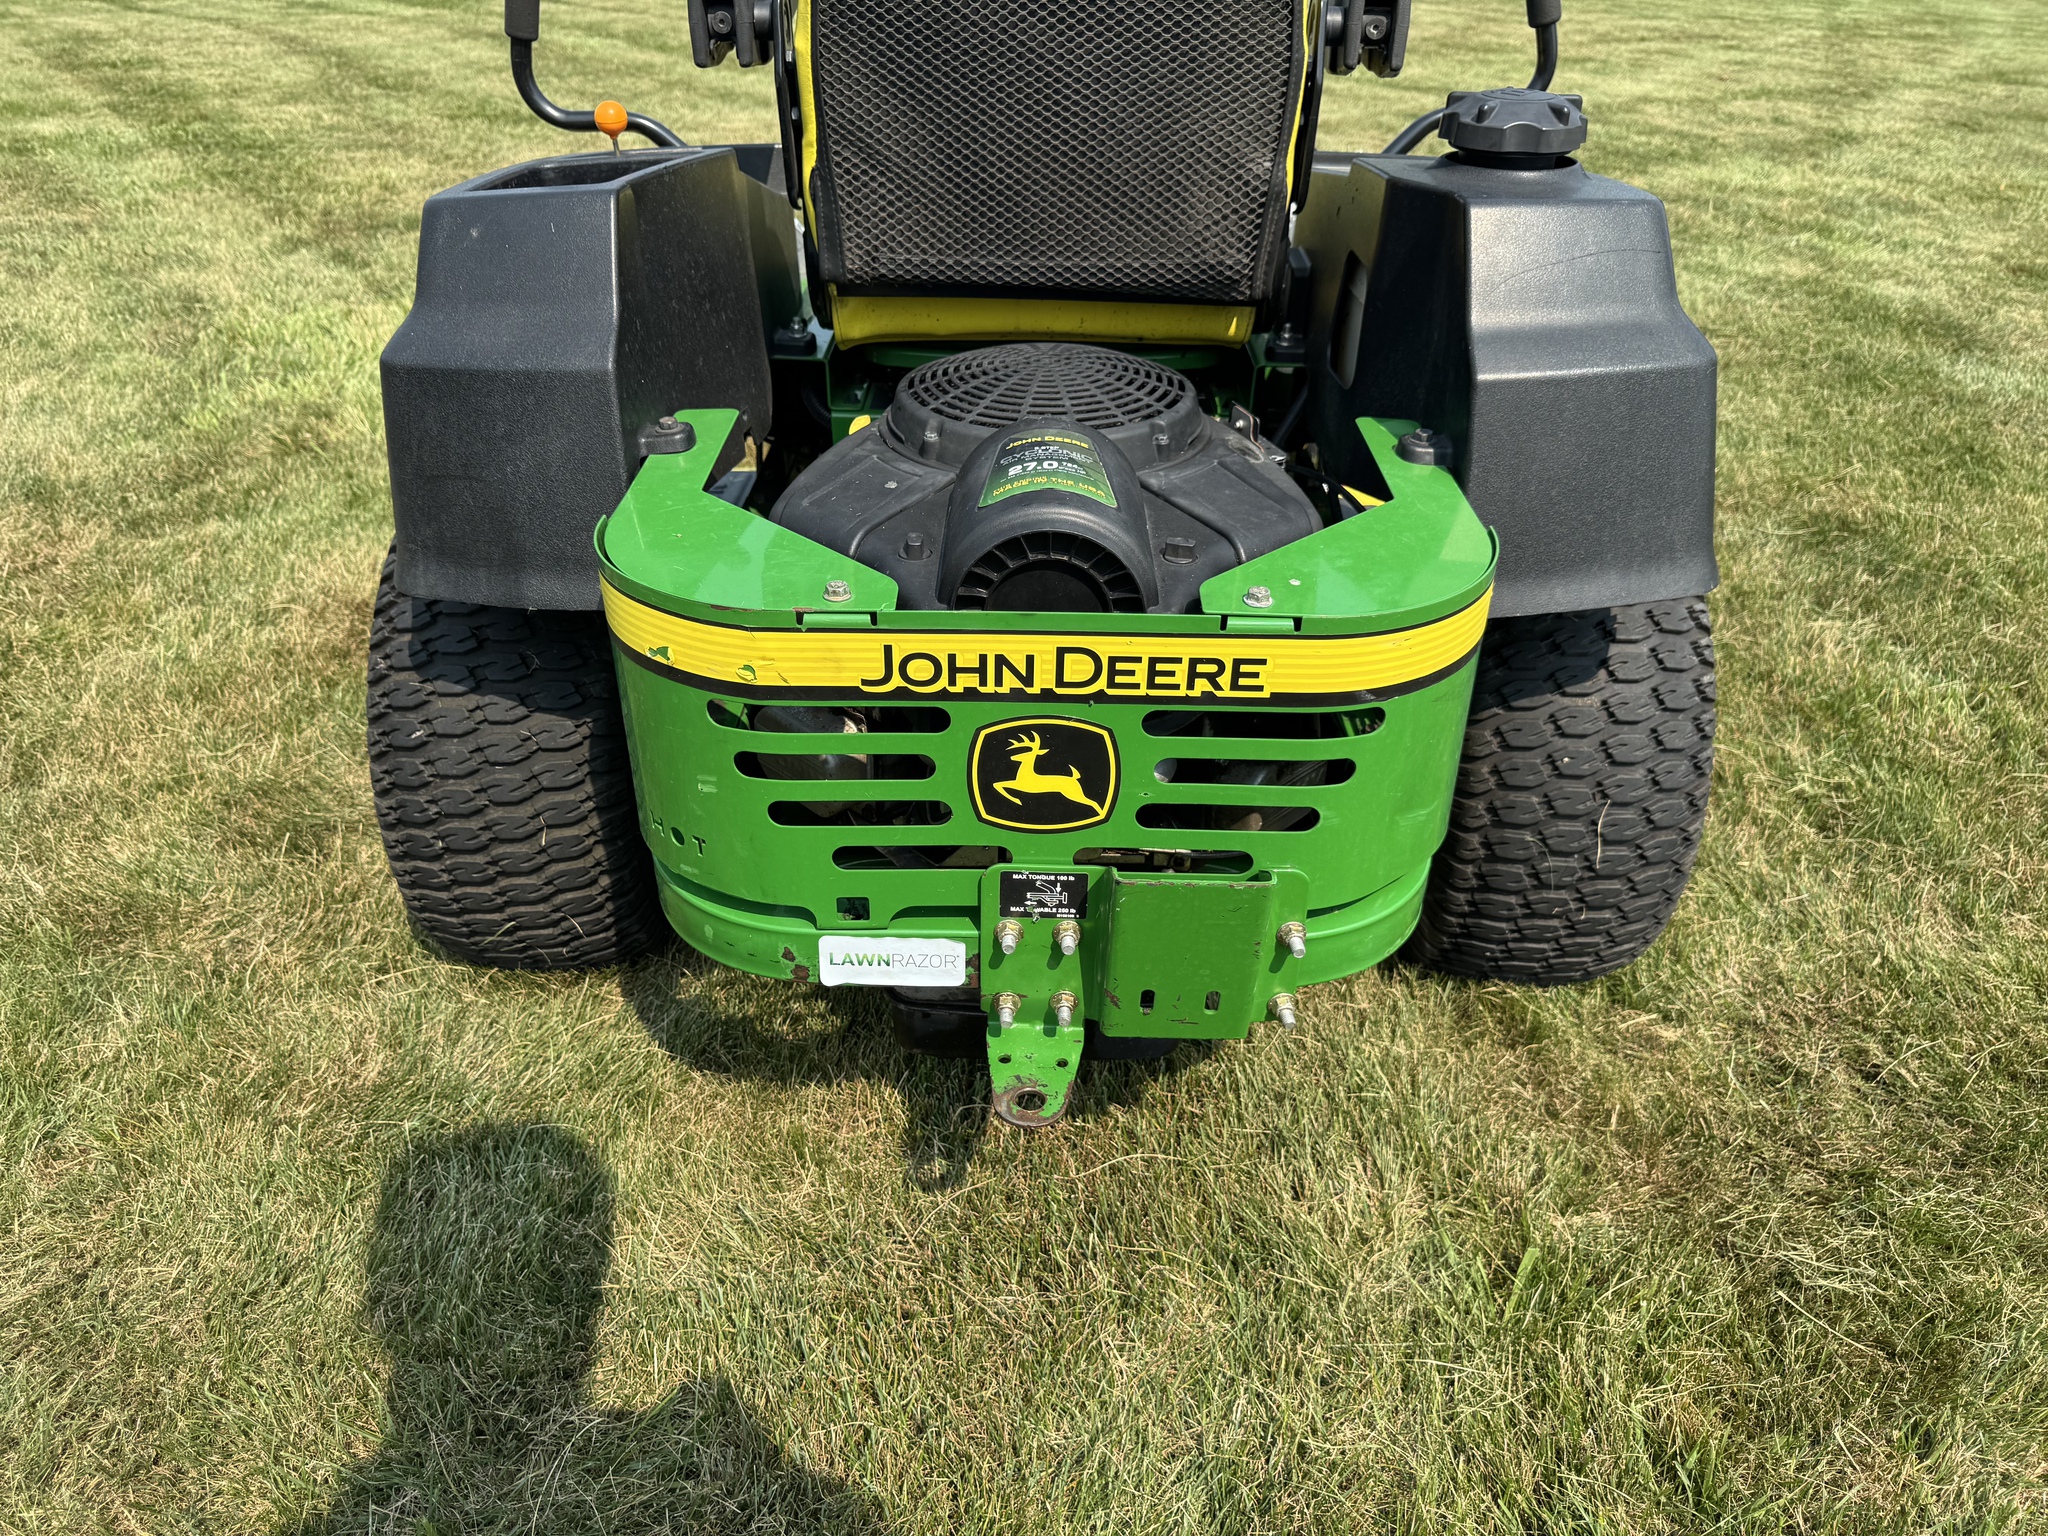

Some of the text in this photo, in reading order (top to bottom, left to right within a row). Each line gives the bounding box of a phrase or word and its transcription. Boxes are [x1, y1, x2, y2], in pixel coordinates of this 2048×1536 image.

[1005, 436, 1089, 450] JOHN DEERE
[1000, 449, 1093, 464] CYCLONIC
[1008, 461, 1059, 476] 27.0
[860, 643, 1269, 694] JOHN DEERE
[650, 809, 707, 858] HOT
